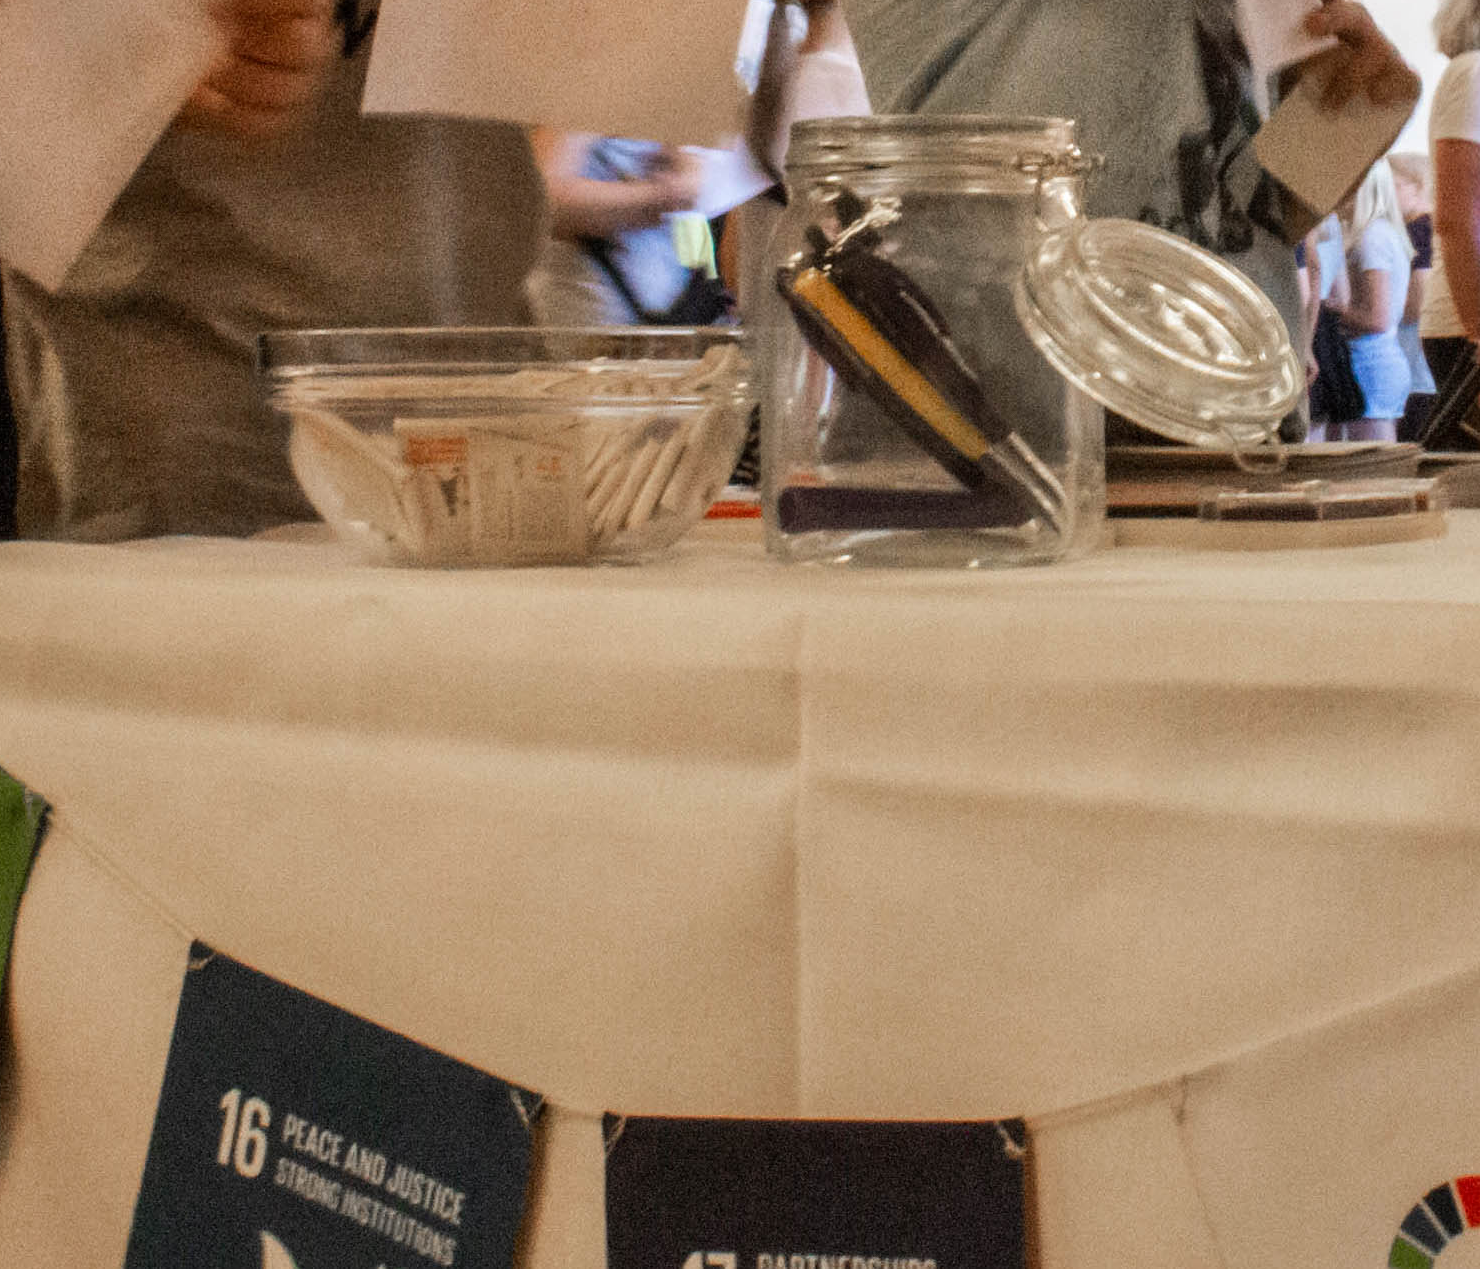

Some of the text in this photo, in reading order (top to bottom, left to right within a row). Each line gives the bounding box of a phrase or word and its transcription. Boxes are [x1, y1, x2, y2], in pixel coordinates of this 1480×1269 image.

[217, 1088, 271, 1179] 16
[282, 1113, 465, 1226] PEACE AND JUSTICE
[274, 1157, 457, 1266] STRONG INSTITUTIONS
